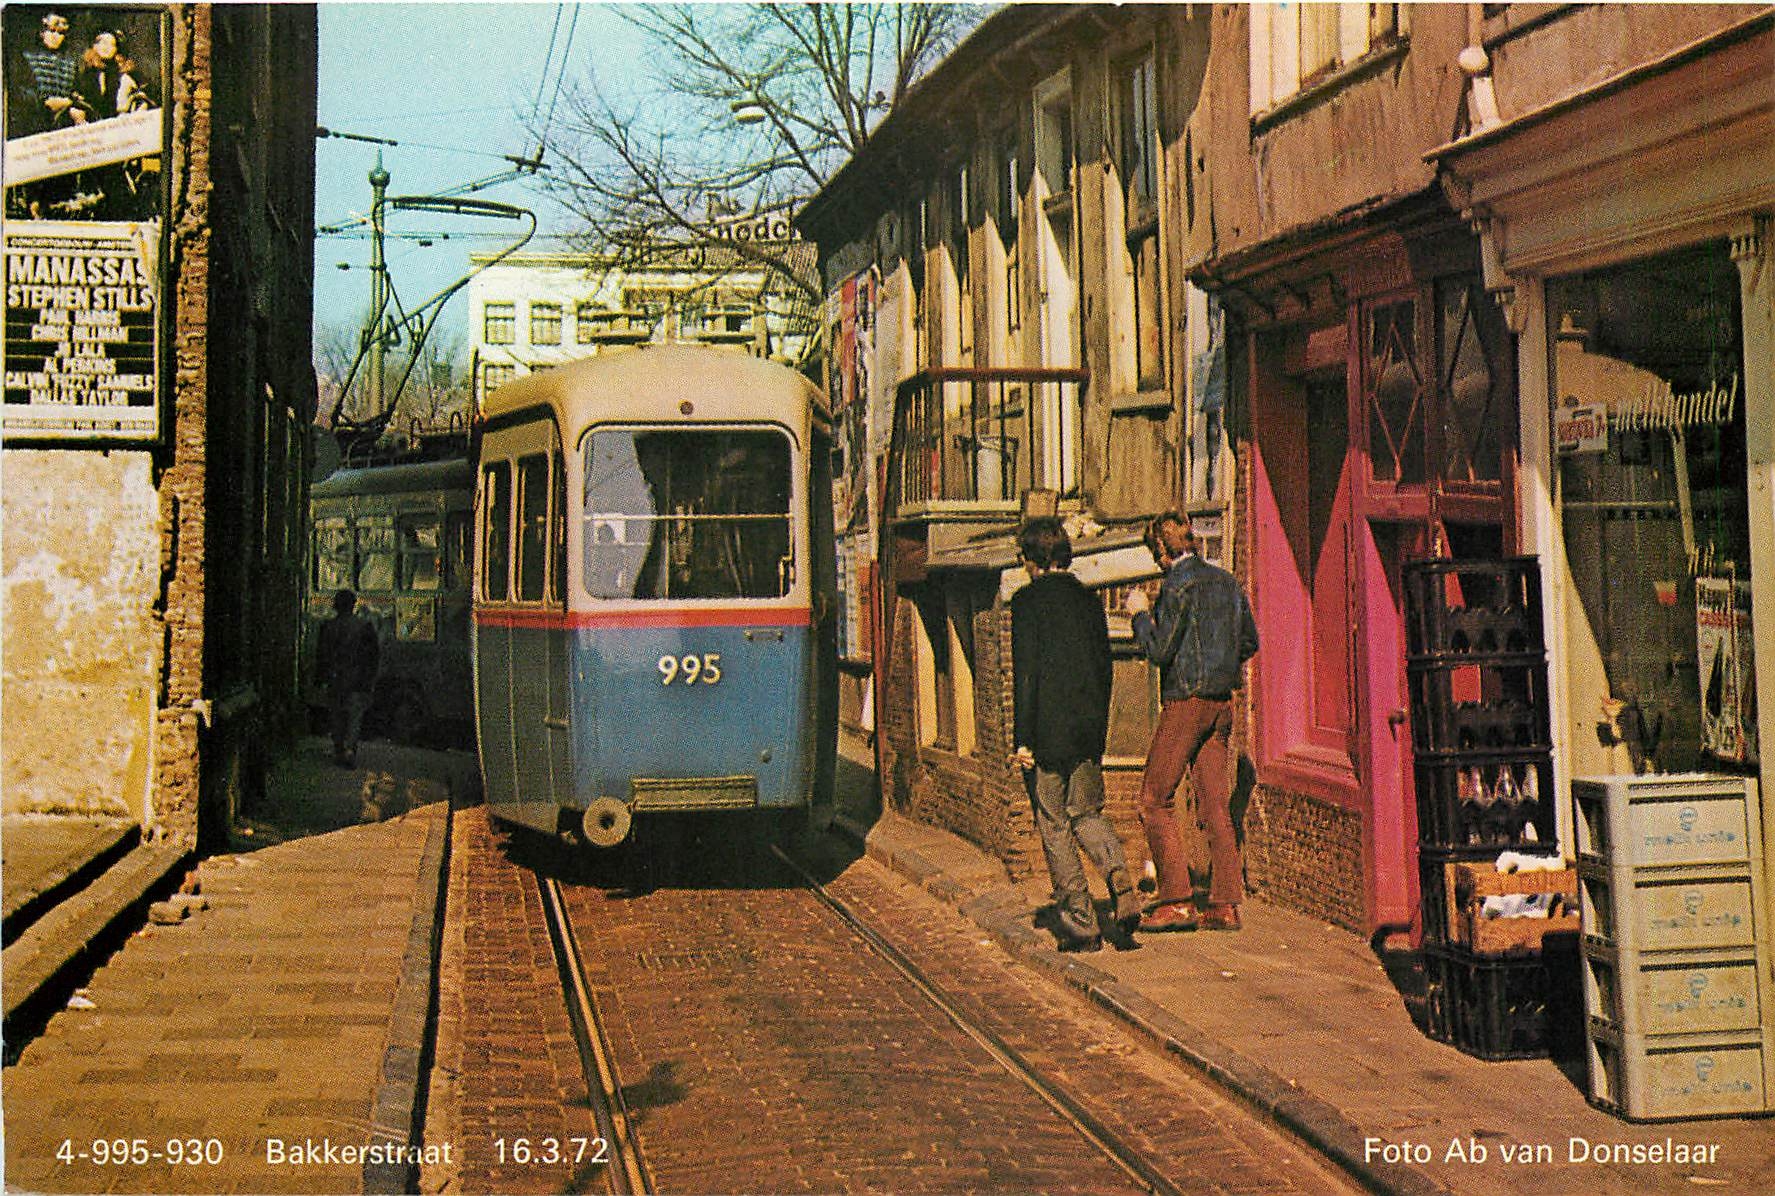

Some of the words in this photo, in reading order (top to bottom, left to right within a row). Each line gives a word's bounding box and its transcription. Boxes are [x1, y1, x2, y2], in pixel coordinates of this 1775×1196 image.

[9, 255, 148, 286] MANASSAS
[8, 285, 90, 309] STEPHEN
[93, 287, 154, 311] STILLS
[74, 343, 106, 358] LALA
[62, 357, 117, 375] PERKINS
[5, 371, 50, 389] CALVIN
[97, 374, 155, 391] SAMUELS
[30, 389, 78, 404] DALLAS
[81, 390, 129, 405] TAYLOR
[1615, 371, 1738, 432] melkhandel
[657, 653, 722, 686] 995
